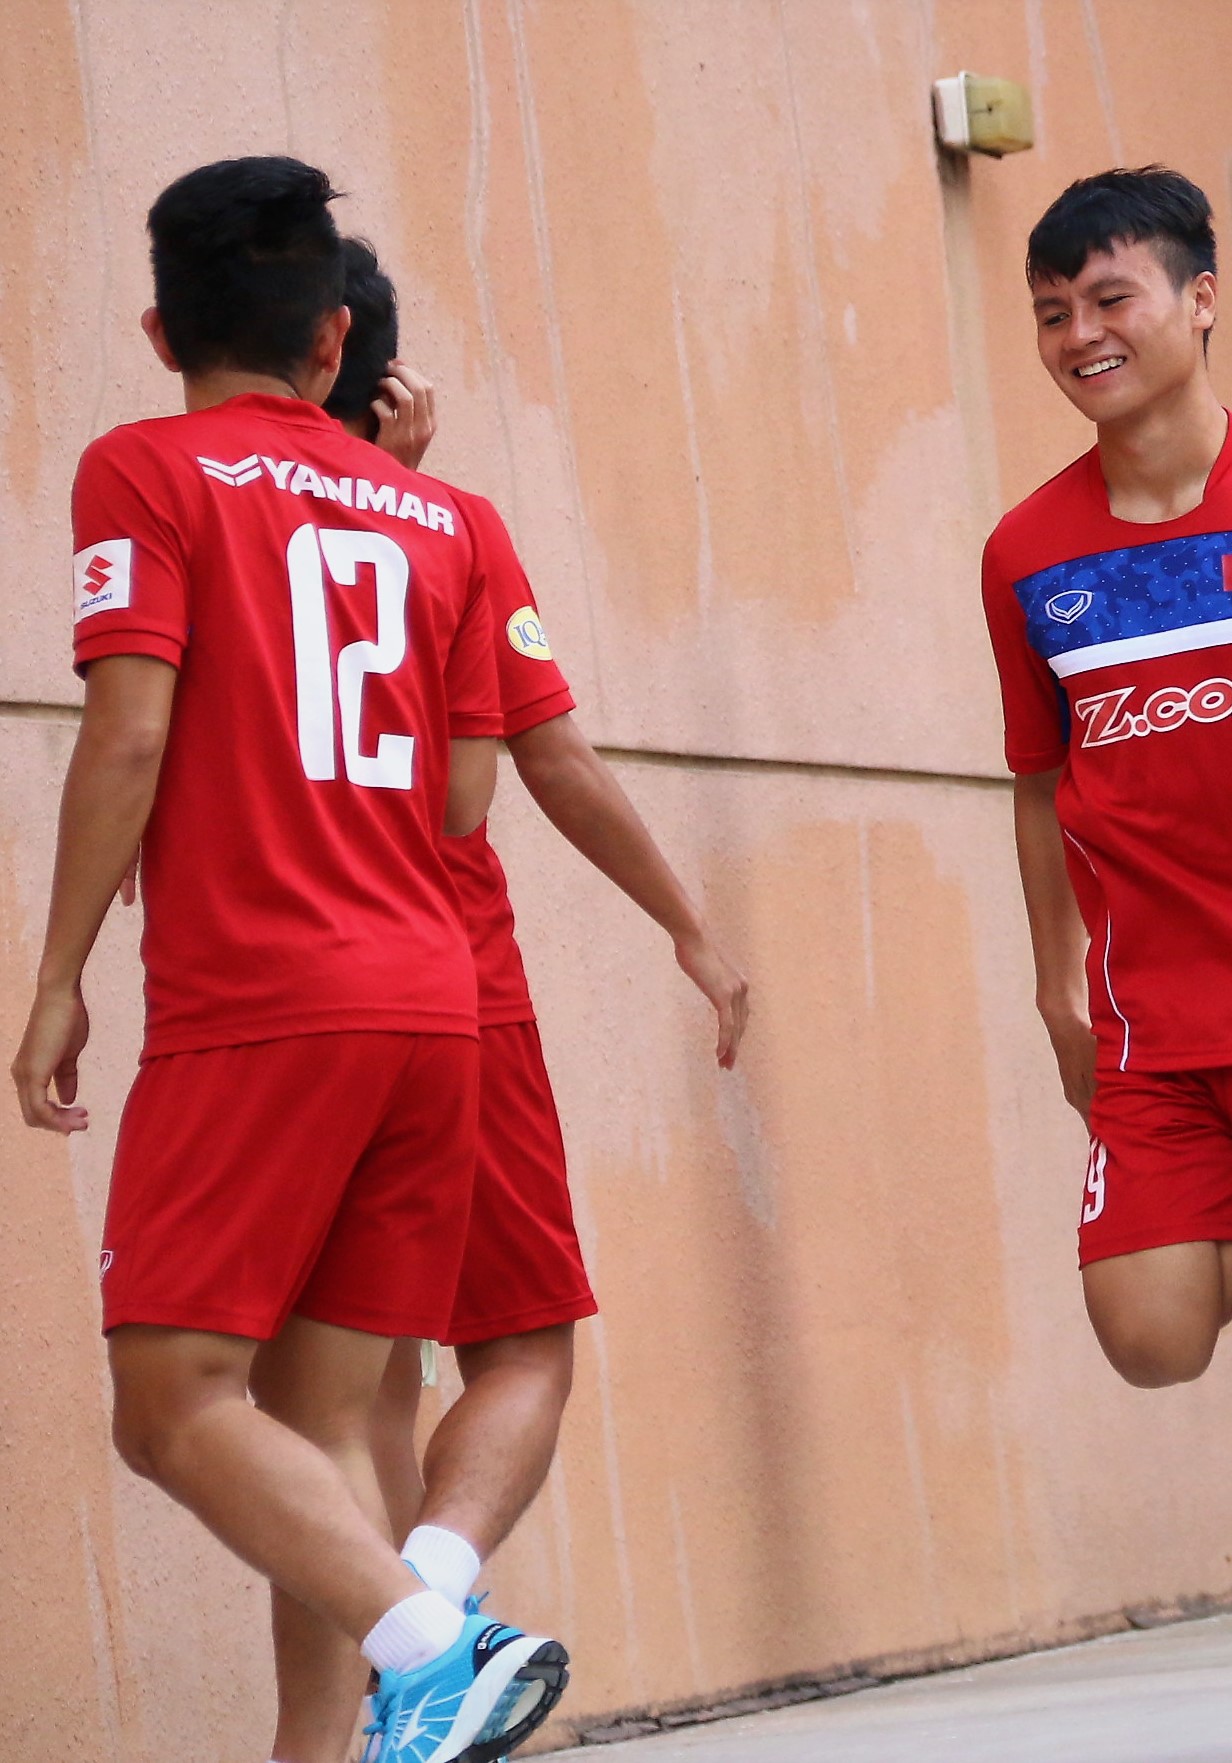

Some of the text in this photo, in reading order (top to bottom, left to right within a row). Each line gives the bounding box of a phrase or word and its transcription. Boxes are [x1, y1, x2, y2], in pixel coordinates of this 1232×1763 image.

[260, 455, 455, 537] YANMAR
[80, 591, 113, 609] SUZUKI
[286, 523, 415, 791] 12
